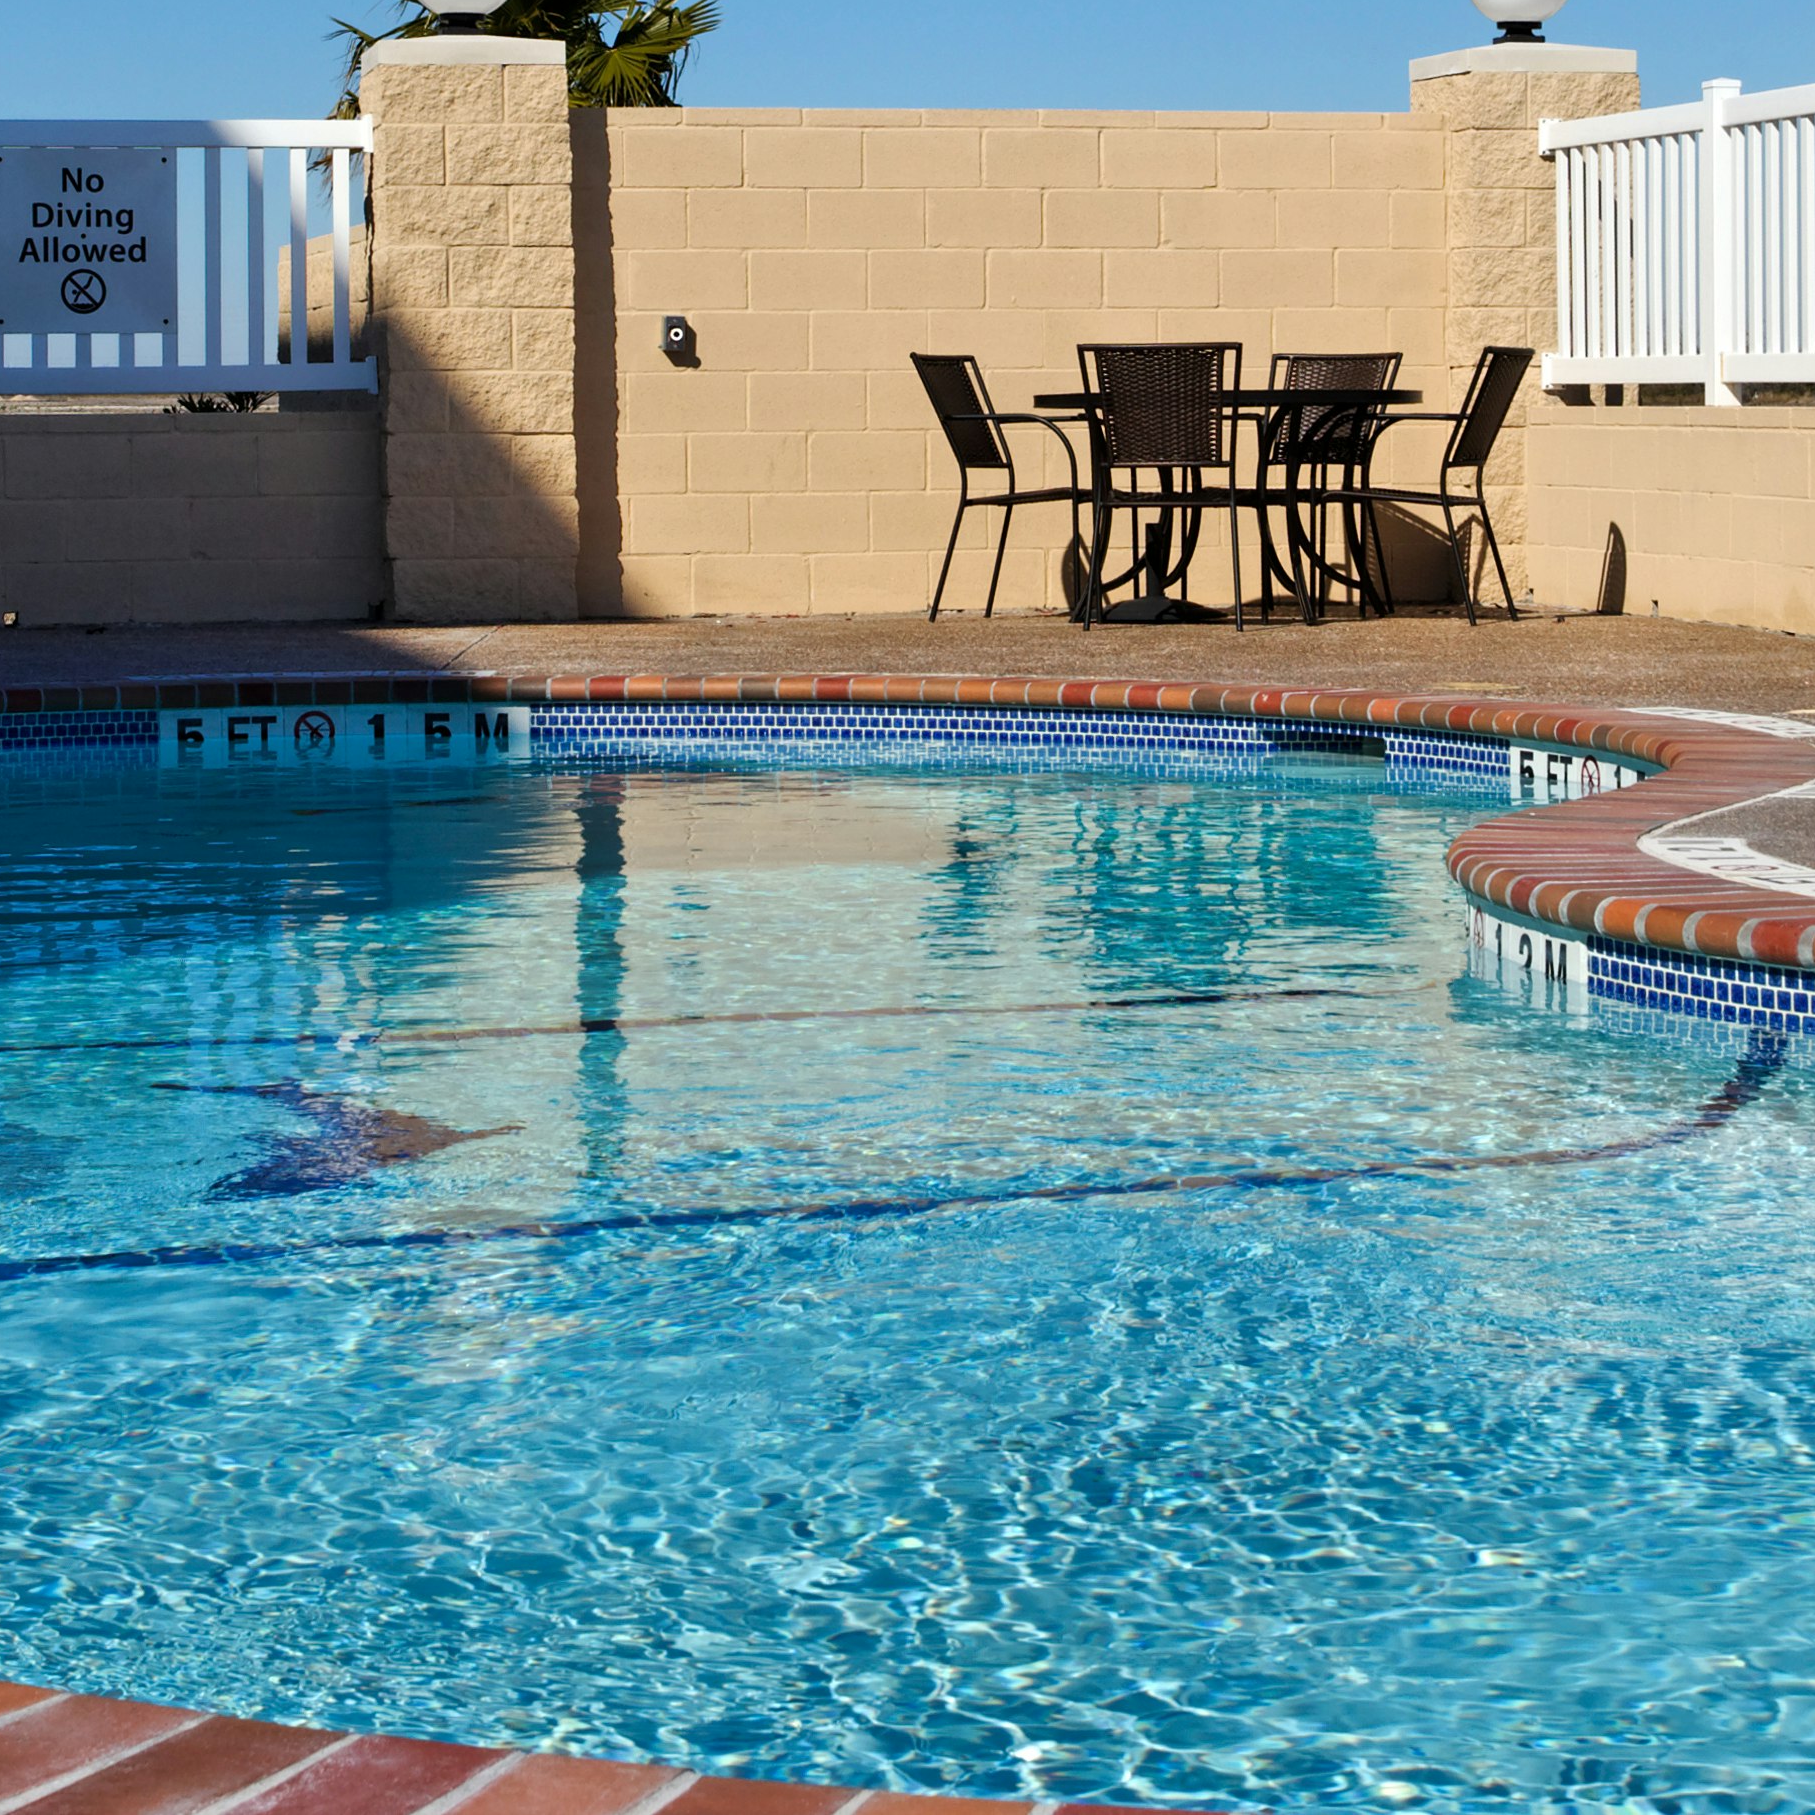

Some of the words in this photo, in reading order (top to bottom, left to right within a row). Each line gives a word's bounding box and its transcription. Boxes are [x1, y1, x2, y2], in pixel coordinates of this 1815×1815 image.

[61, 167, 104, 193] No
[32, 202, 134, 234] Diving
[18, 236, 147, 263] Allowed
[228, 716, 277, 740] FT
[1547, 753, 1573, 784] FT
